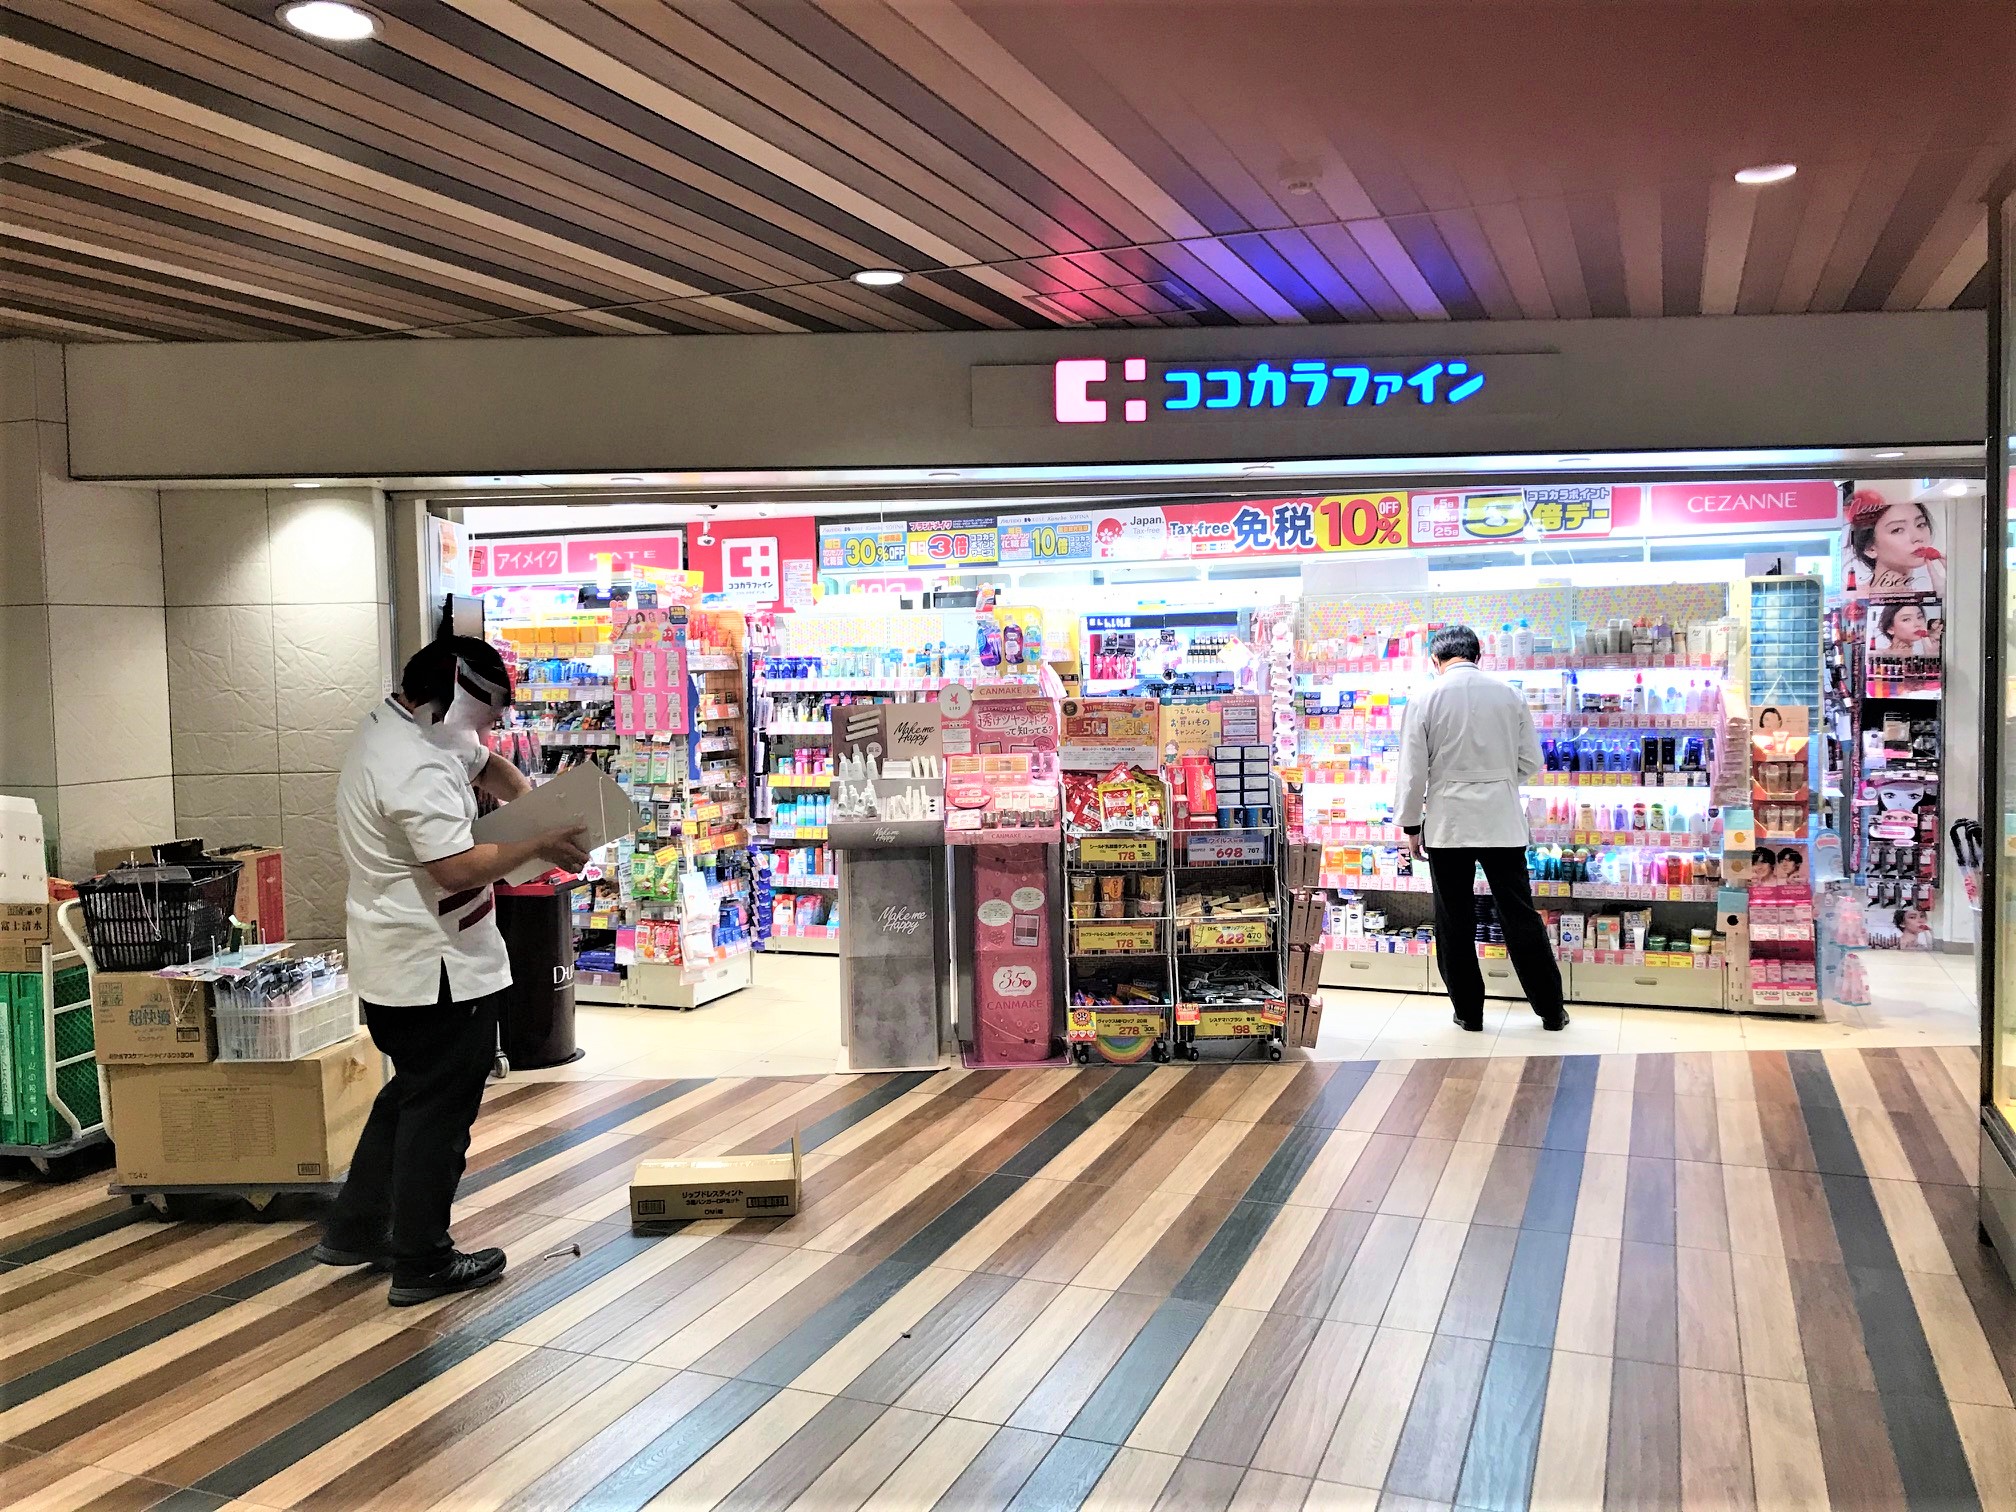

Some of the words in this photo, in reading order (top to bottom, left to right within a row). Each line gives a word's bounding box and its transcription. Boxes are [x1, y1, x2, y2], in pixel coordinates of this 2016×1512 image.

[1164, 361, 1485, 410] ココカラファイン
[1528, 486, 1610, 502] ココカラポイント
[1686, 491, 1798, 514] CEZANNE
[1169, 520, 1230, 537] Tax-free
[1232, 504, 1314, 549] 免税
[1320, 500, 1401, 547] 10%
[1379, 500, 1399, 515] OFF
[1434, 527, 1459, 537] 25日
[497, 550, 559, 570] アイメイク
[728, 581, 774, 590] ココカラファイン
[979, 687, 1022, 695] CANMAKE
[977, 712, 1049, 728] 透けツヤシャドウ
[893, 721, 921, 735] Make
[921, 724, 935, 733] me
[897, 732, 930, 746] Happy
[1117, 851, 1136, 860] 178
[1216, 847, 1243, 858] 698
[877, 905, 910, 922] Make
[909, 910, 928, 921] me
[882, 918, 920, 935] Happy
[1116, 939, 1135, 948] 178
[1215, 932, 1246, 944] 428
[986, 999, 1043, 1011] CANMAKE
[1118, 1026, 1140, 1035] 278
[1231, 1024, 1251, 1034] 198
[681, 1189, 744, 1199] リップドレスティント
